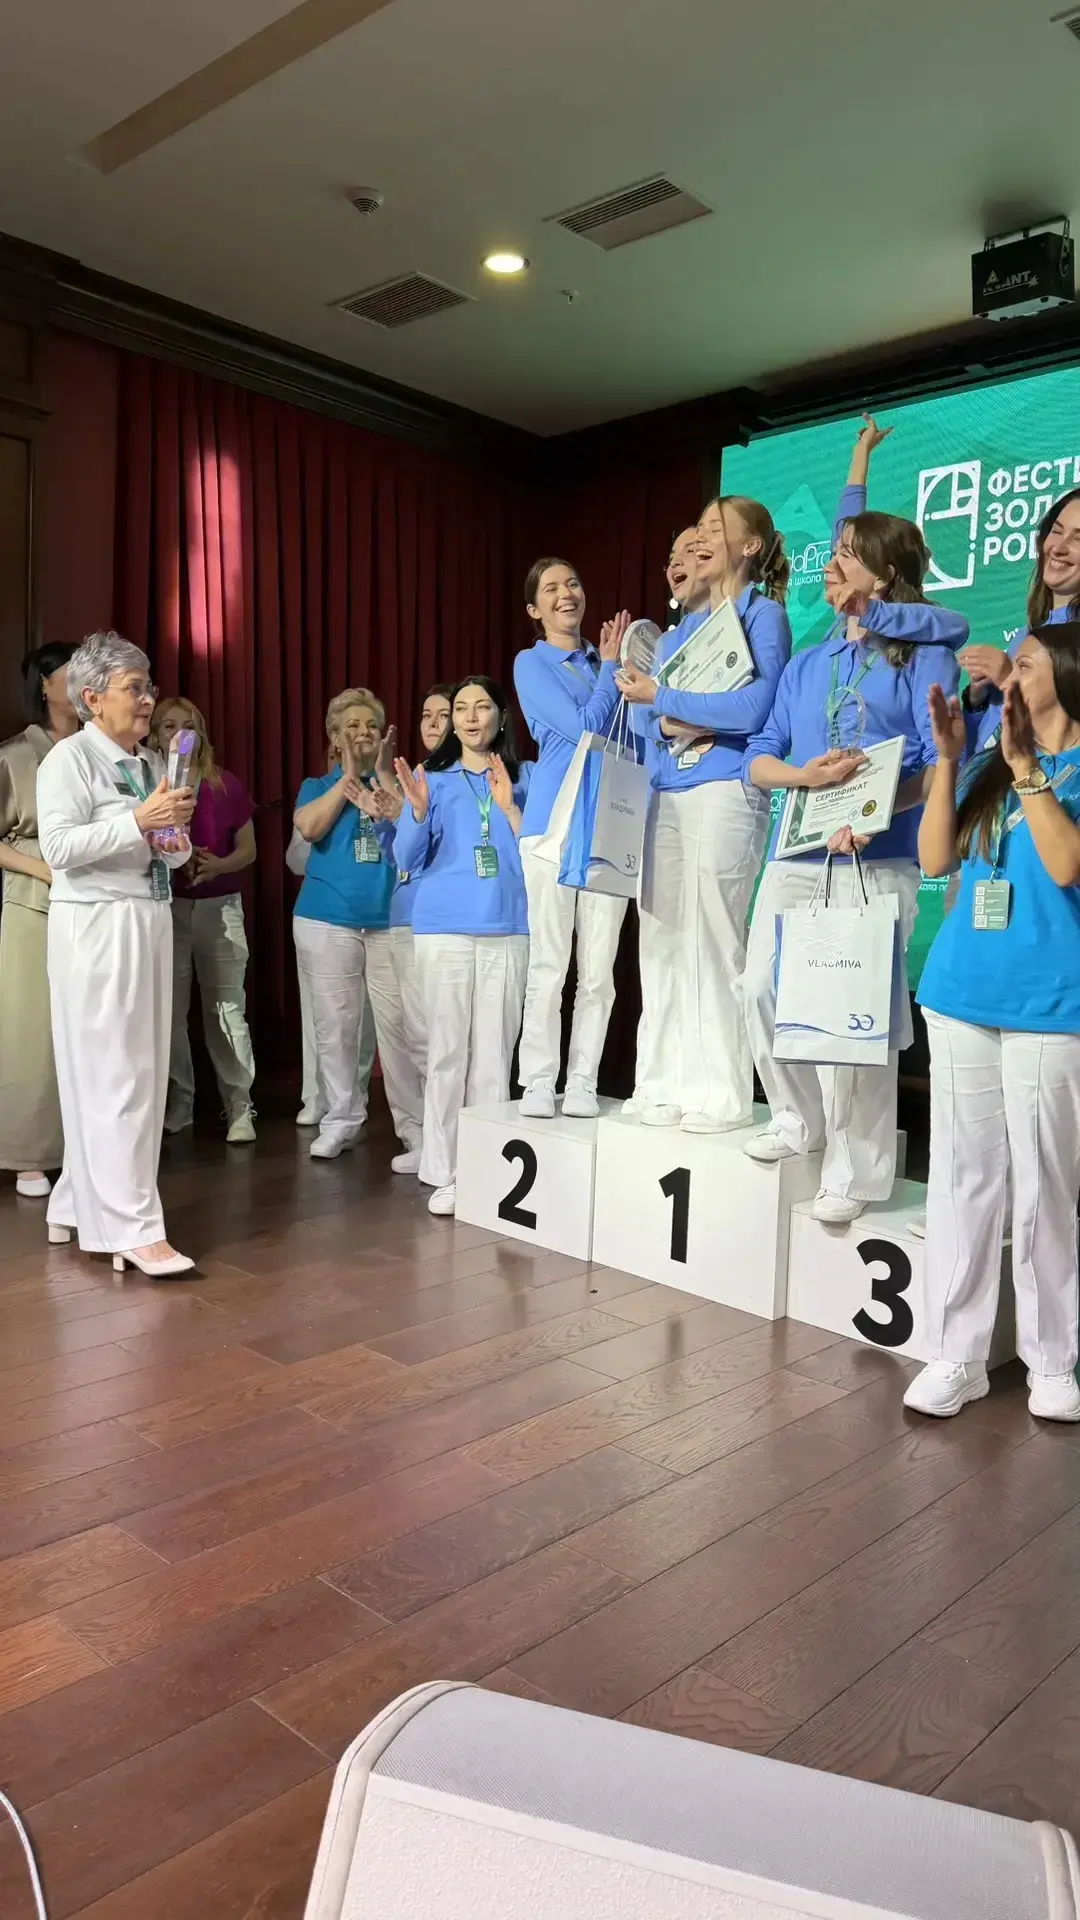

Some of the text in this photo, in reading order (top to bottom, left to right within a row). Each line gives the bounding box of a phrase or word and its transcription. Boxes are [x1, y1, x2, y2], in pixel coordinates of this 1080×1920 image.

[984, 489, 1073, 532] ЗОЛ
[794, 574, 822, 587] школа
[815, 780, 869, 803] СЕРТИФИКАТ
[807, 959, 862, 969] VLADMIVA
[847, 1013, 876, 1032] 30
[497, 1138, 538, 1231] 2
[658, 1166, 691, 1264] 1
[851, 1238, 915, 1348] 3
